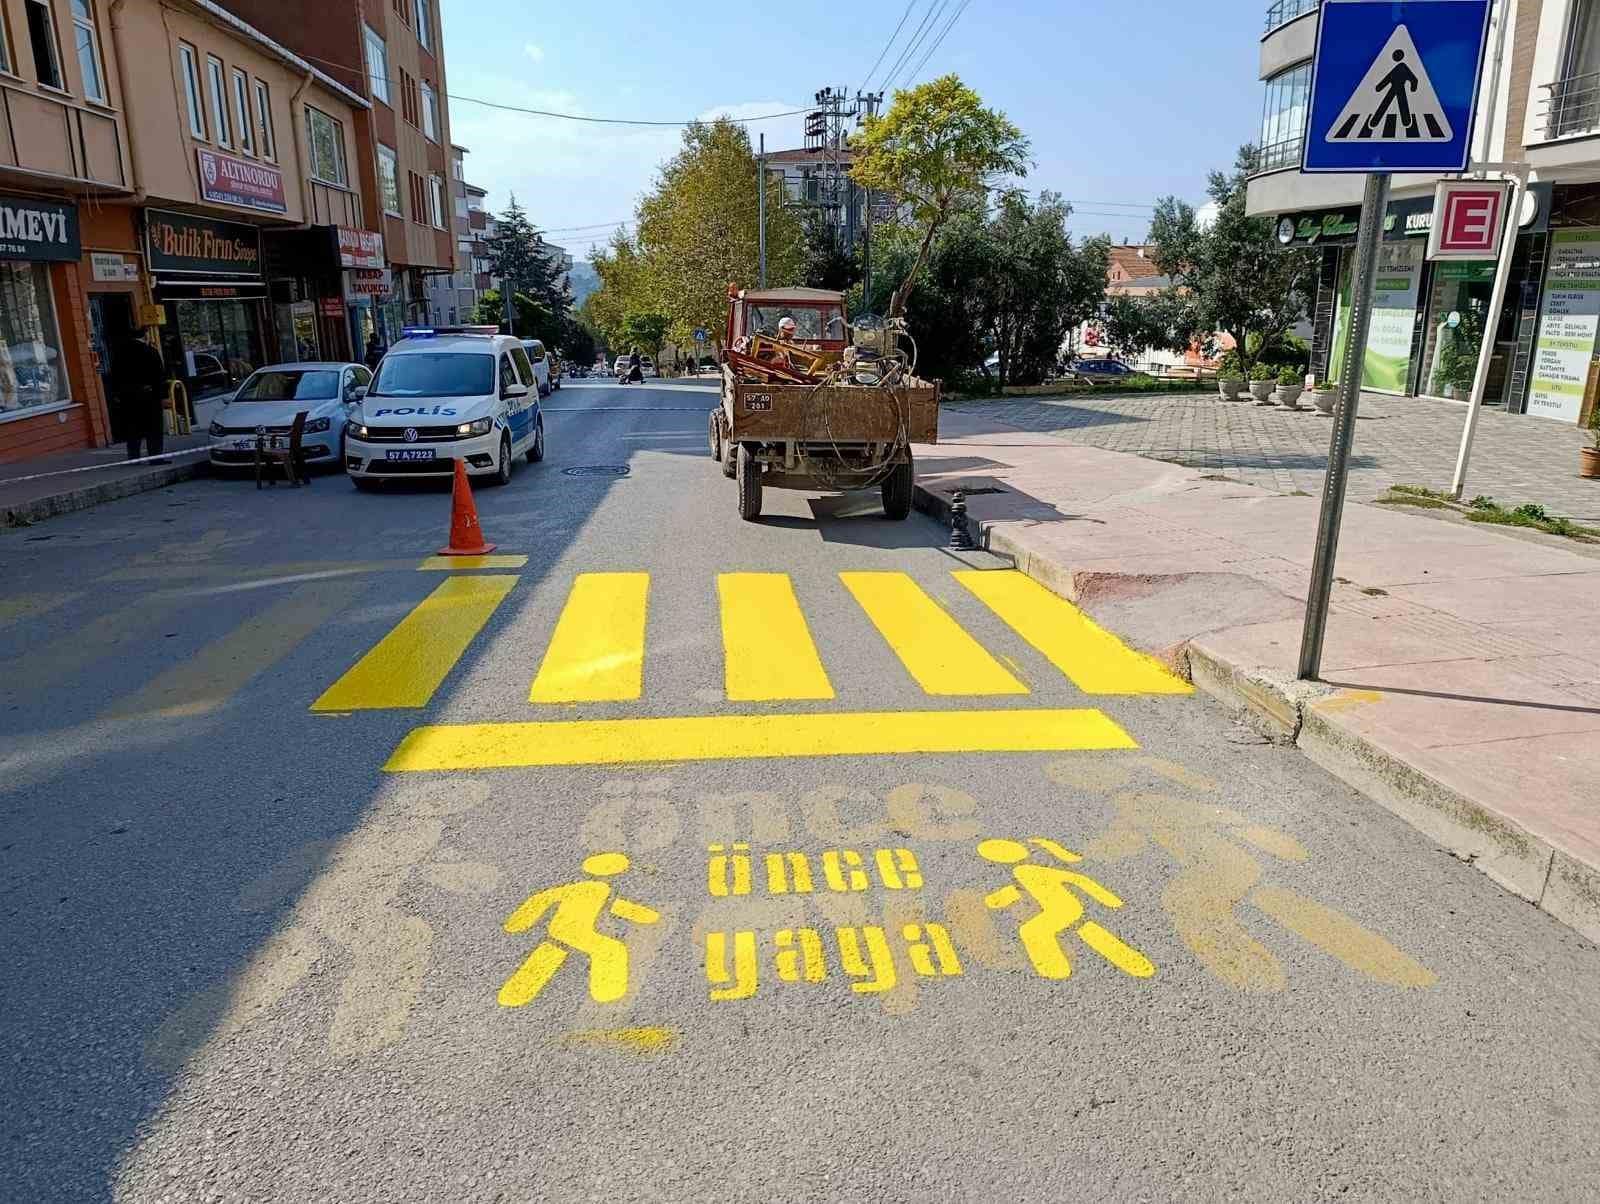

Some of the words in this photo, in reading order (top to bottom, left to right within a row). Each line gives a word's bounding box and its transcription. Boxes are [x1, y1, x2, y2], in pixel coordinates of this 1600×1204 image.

[221, 159, 279, 189] ALTINORDU
[1446, 196, 1495, 247] E
[162, 223, 201, 257] Butik
[352, 284, 390, 295] TAVUKÇU
[357, 270, 384, 280] KASAP
[375, 405, 457, 417] POLİS
[389, 451, 400, 459] 57
[410, 450, 433, 459] 7222
[708, 843, 923, 897] önce
[706, 920, 962, 1001] yaya
